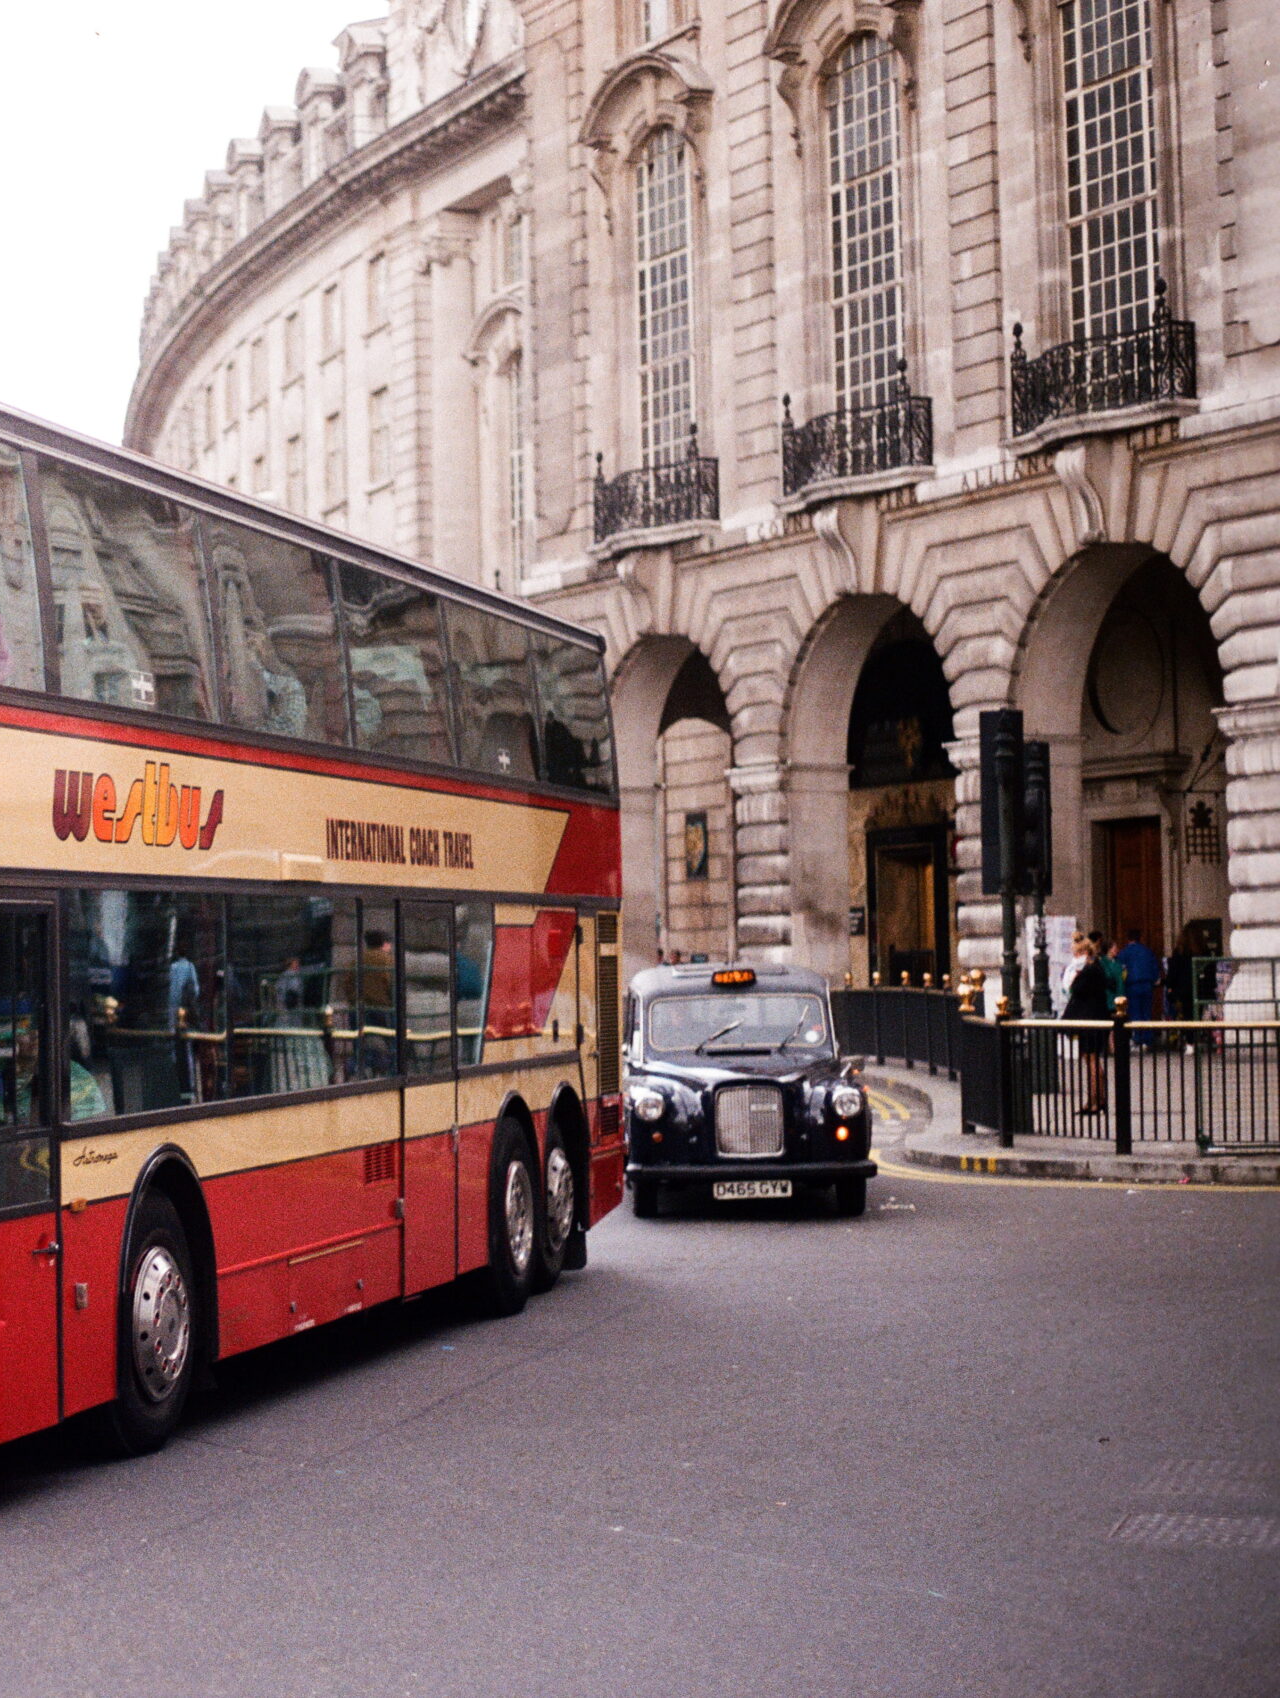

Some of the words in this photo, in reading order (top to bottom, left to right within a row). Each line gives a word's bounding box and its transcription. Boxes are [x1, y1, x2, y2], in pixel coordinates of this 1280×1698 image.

[53, 760, 224, 850] westbus
[326, 818, 406, 865] INTERNATIONAL
[410, 826, 439, 867] COACH
[443, 830, 474, 870] TRAVEL
